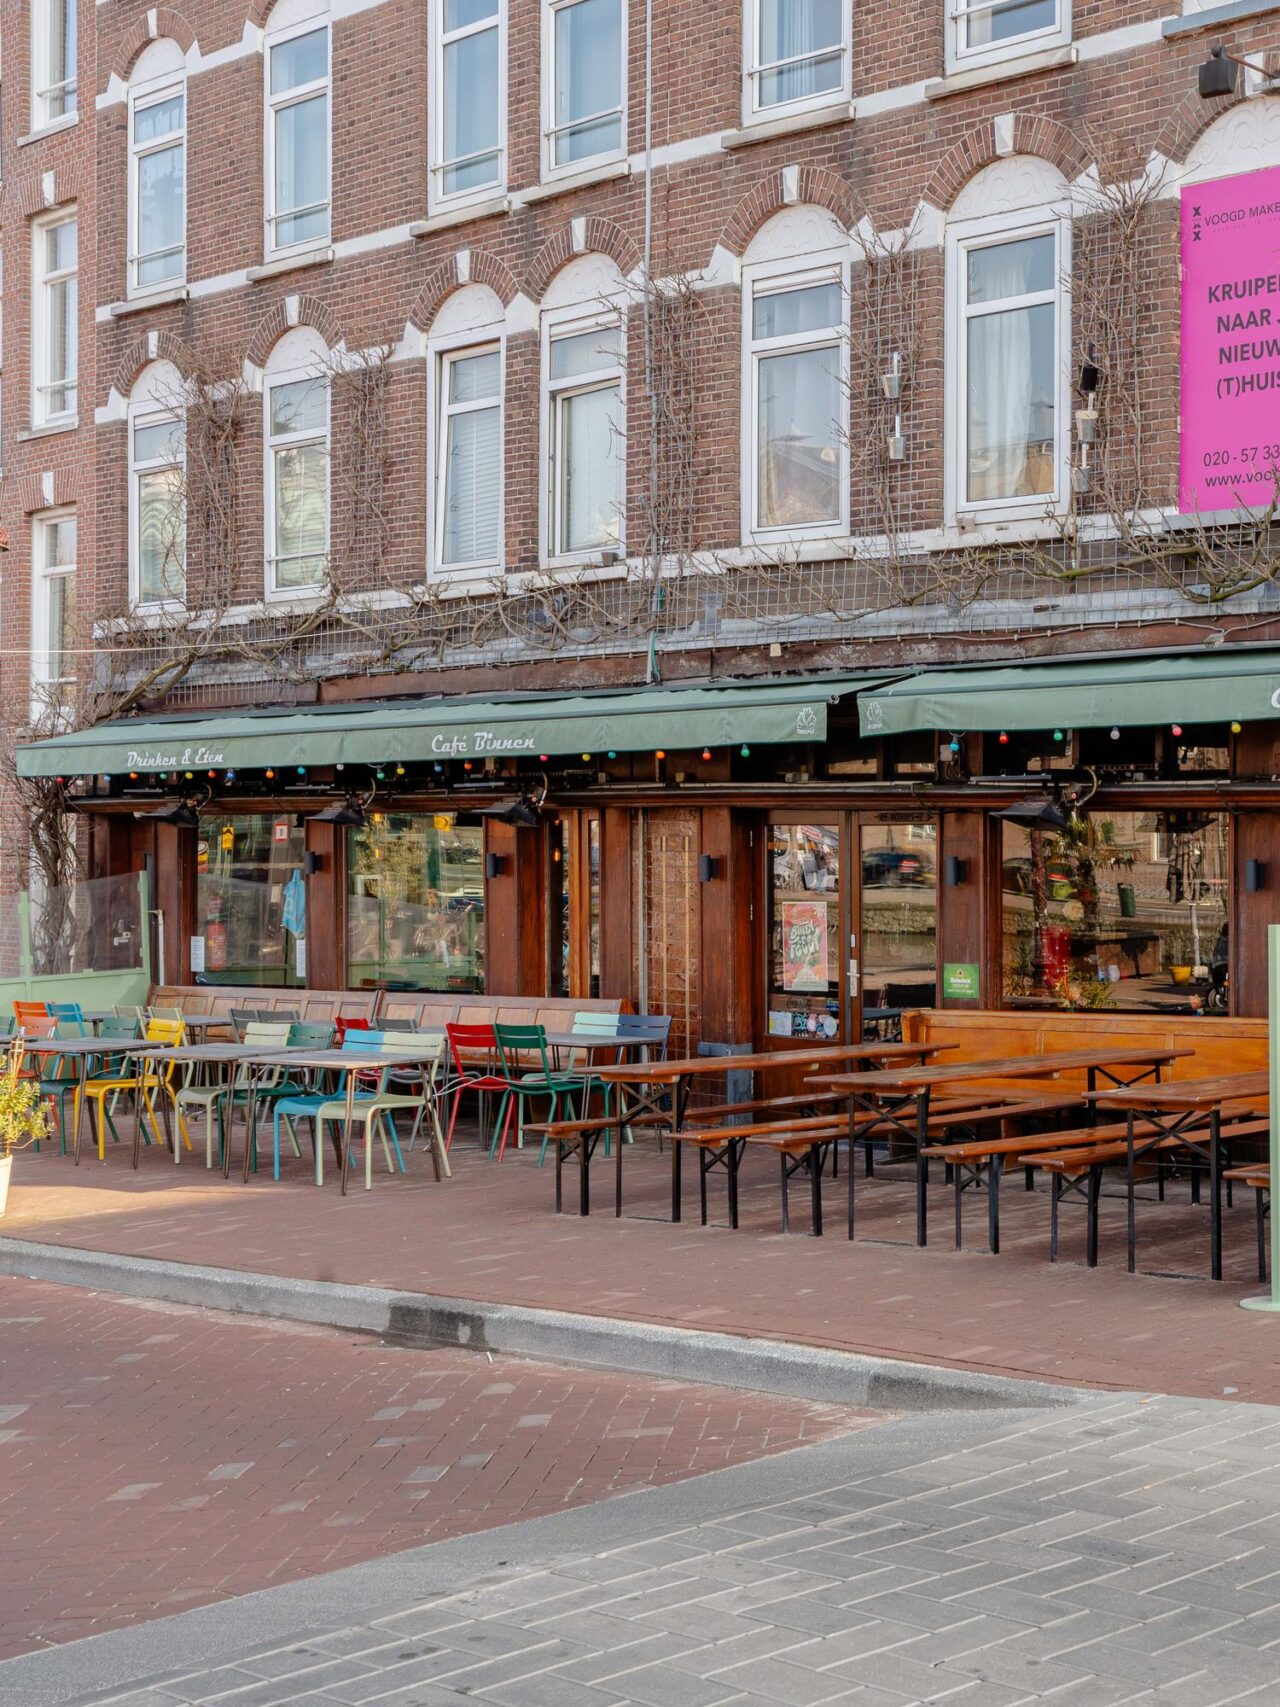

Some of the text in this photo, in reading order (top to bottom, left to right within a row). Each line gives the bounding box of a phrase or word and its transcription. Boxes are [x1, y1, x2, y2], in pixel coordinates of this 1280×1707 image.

[1204, 209, 1246, 227] VOOGD
[1217, 308, 1272, 334] NAAR
[431, 731, 536, 757] Café Binnen
[127, 747, 224, 768] Drinken & Eten
